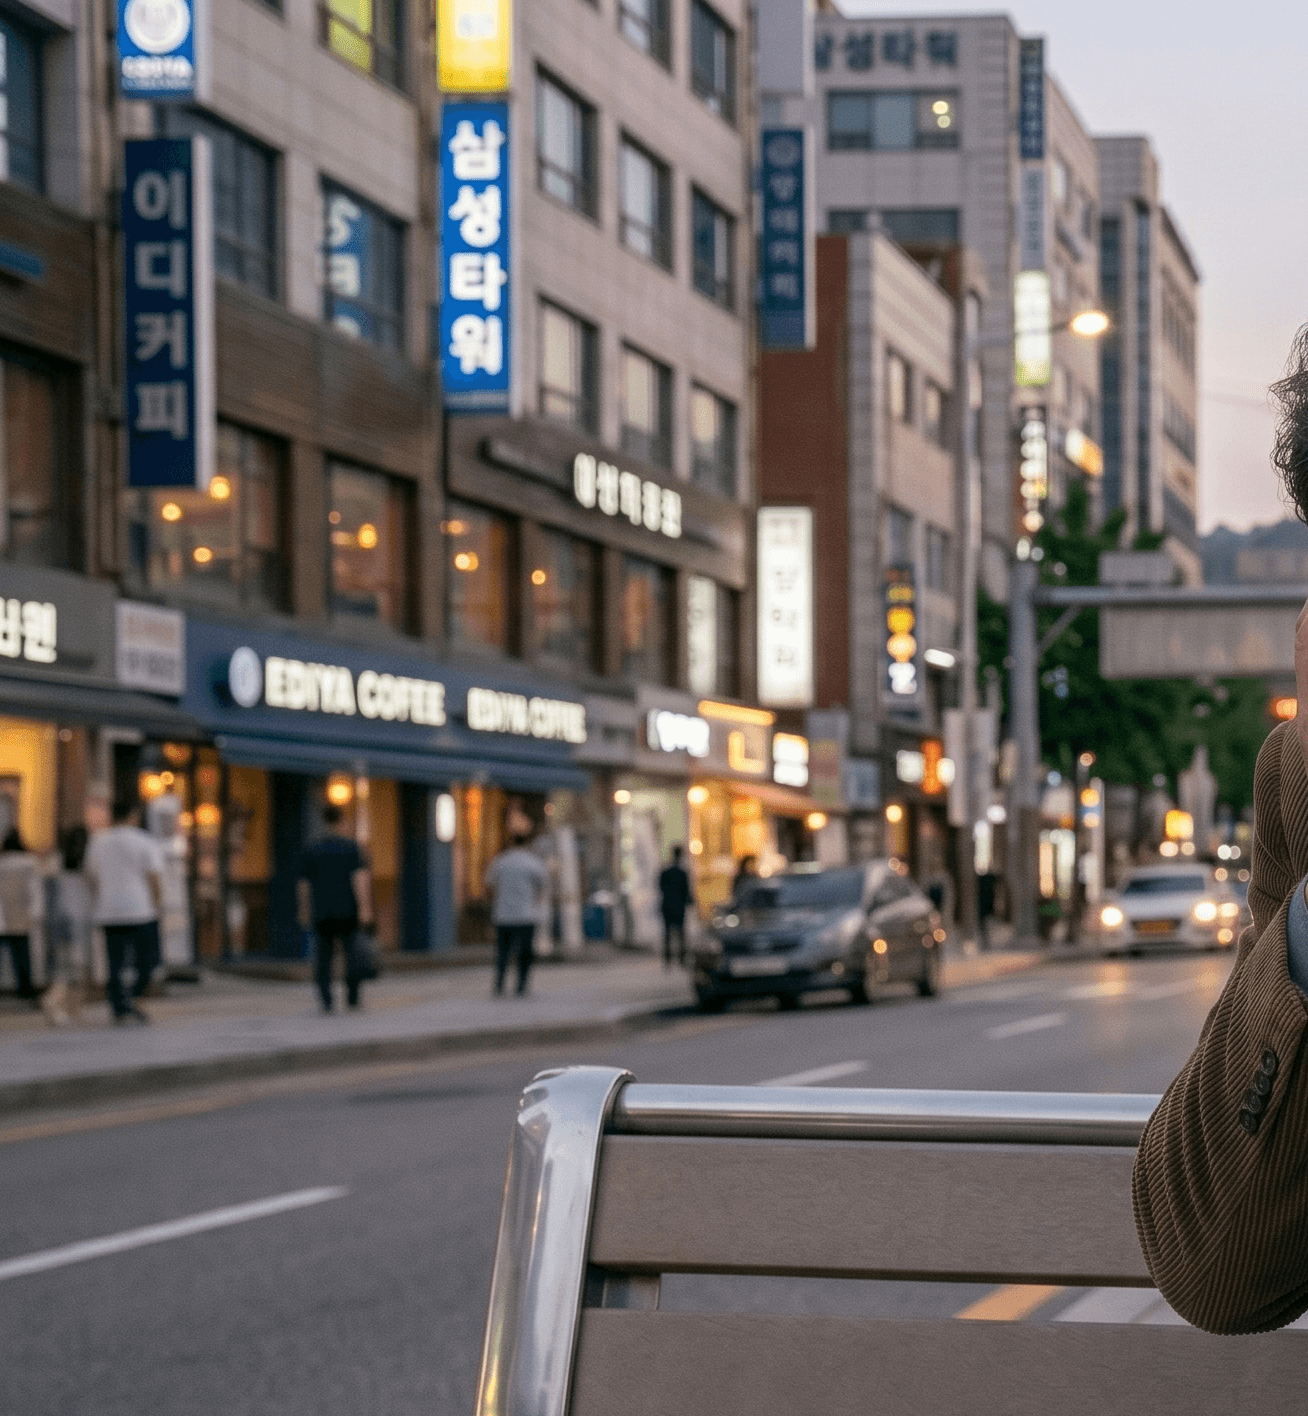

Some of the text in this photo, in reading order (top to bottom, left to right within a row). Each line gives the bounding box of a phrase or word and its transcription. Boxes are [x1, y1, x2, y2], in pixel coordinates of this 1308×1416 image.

[133, 169, 187, 440] 이디커피
[449, 119, 507, 375] 삼성타워
[265, 656, 356, 715] EDIYA
